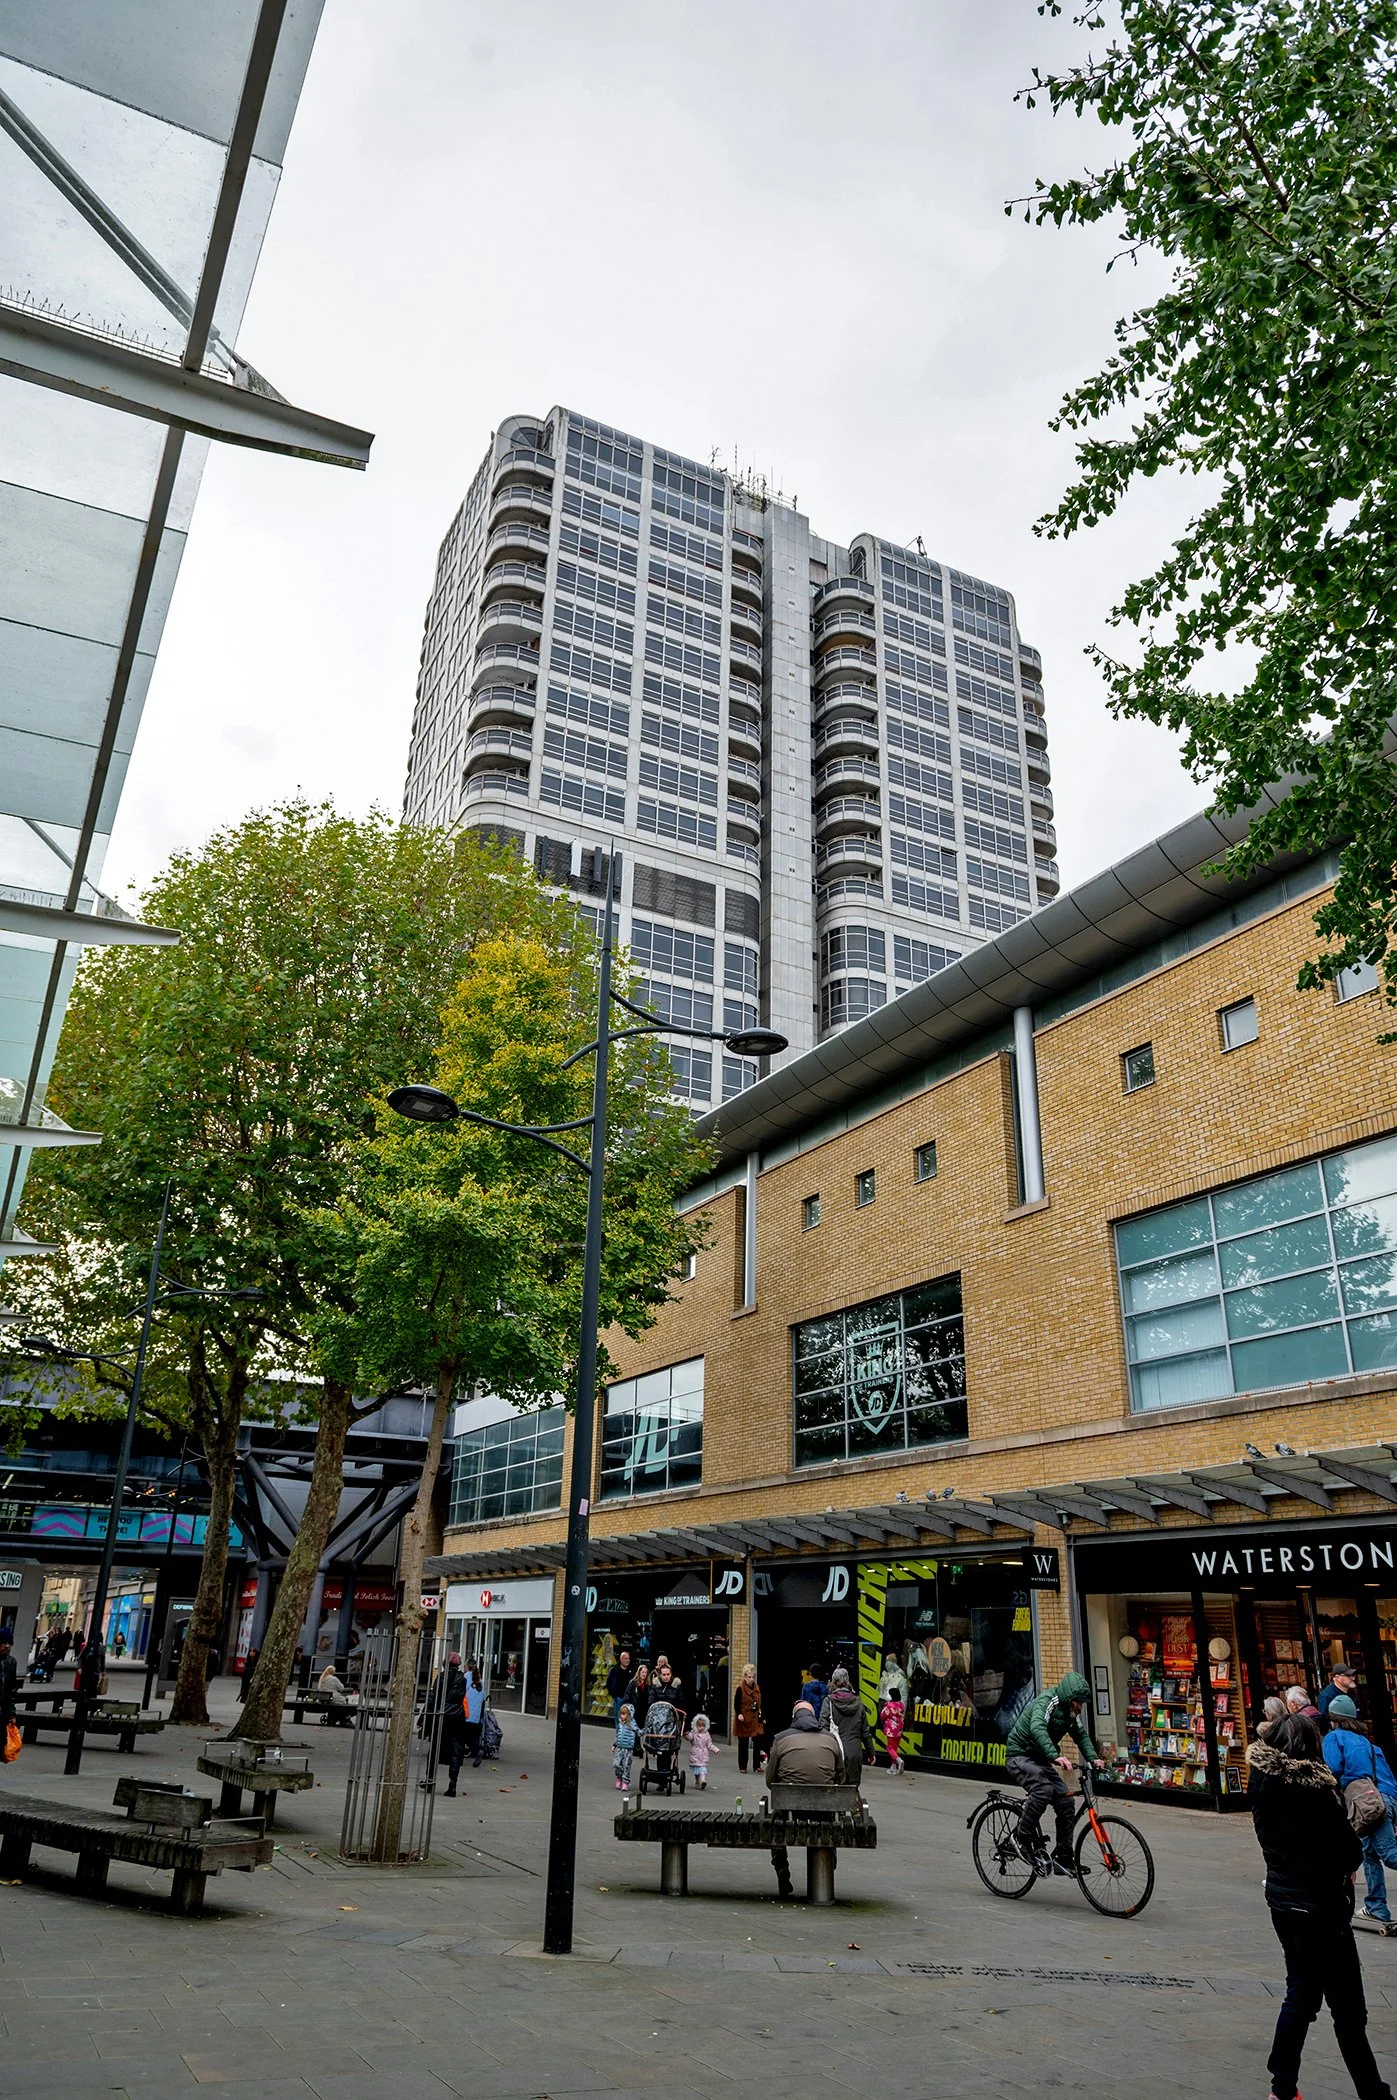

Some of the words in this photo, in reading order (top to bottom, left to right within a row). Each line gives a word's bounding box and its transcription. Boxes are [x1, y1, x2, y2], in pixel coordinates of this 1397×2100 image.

[857, 1356, 893, 1380] KING
[871, 1397, 881, 1410] JD
[1032, 1554, 1054, 1575] W
[0, 1573, 20, 1587] SING
[714, 1571, 744, 1595] JD
[822, 1565, 850, 1602] JD
[663, 1596, 677, 1606] KING
[683, 1595, 710, 1605] TRAINERS
[941, 1738, 984, 1764] FOREVER
